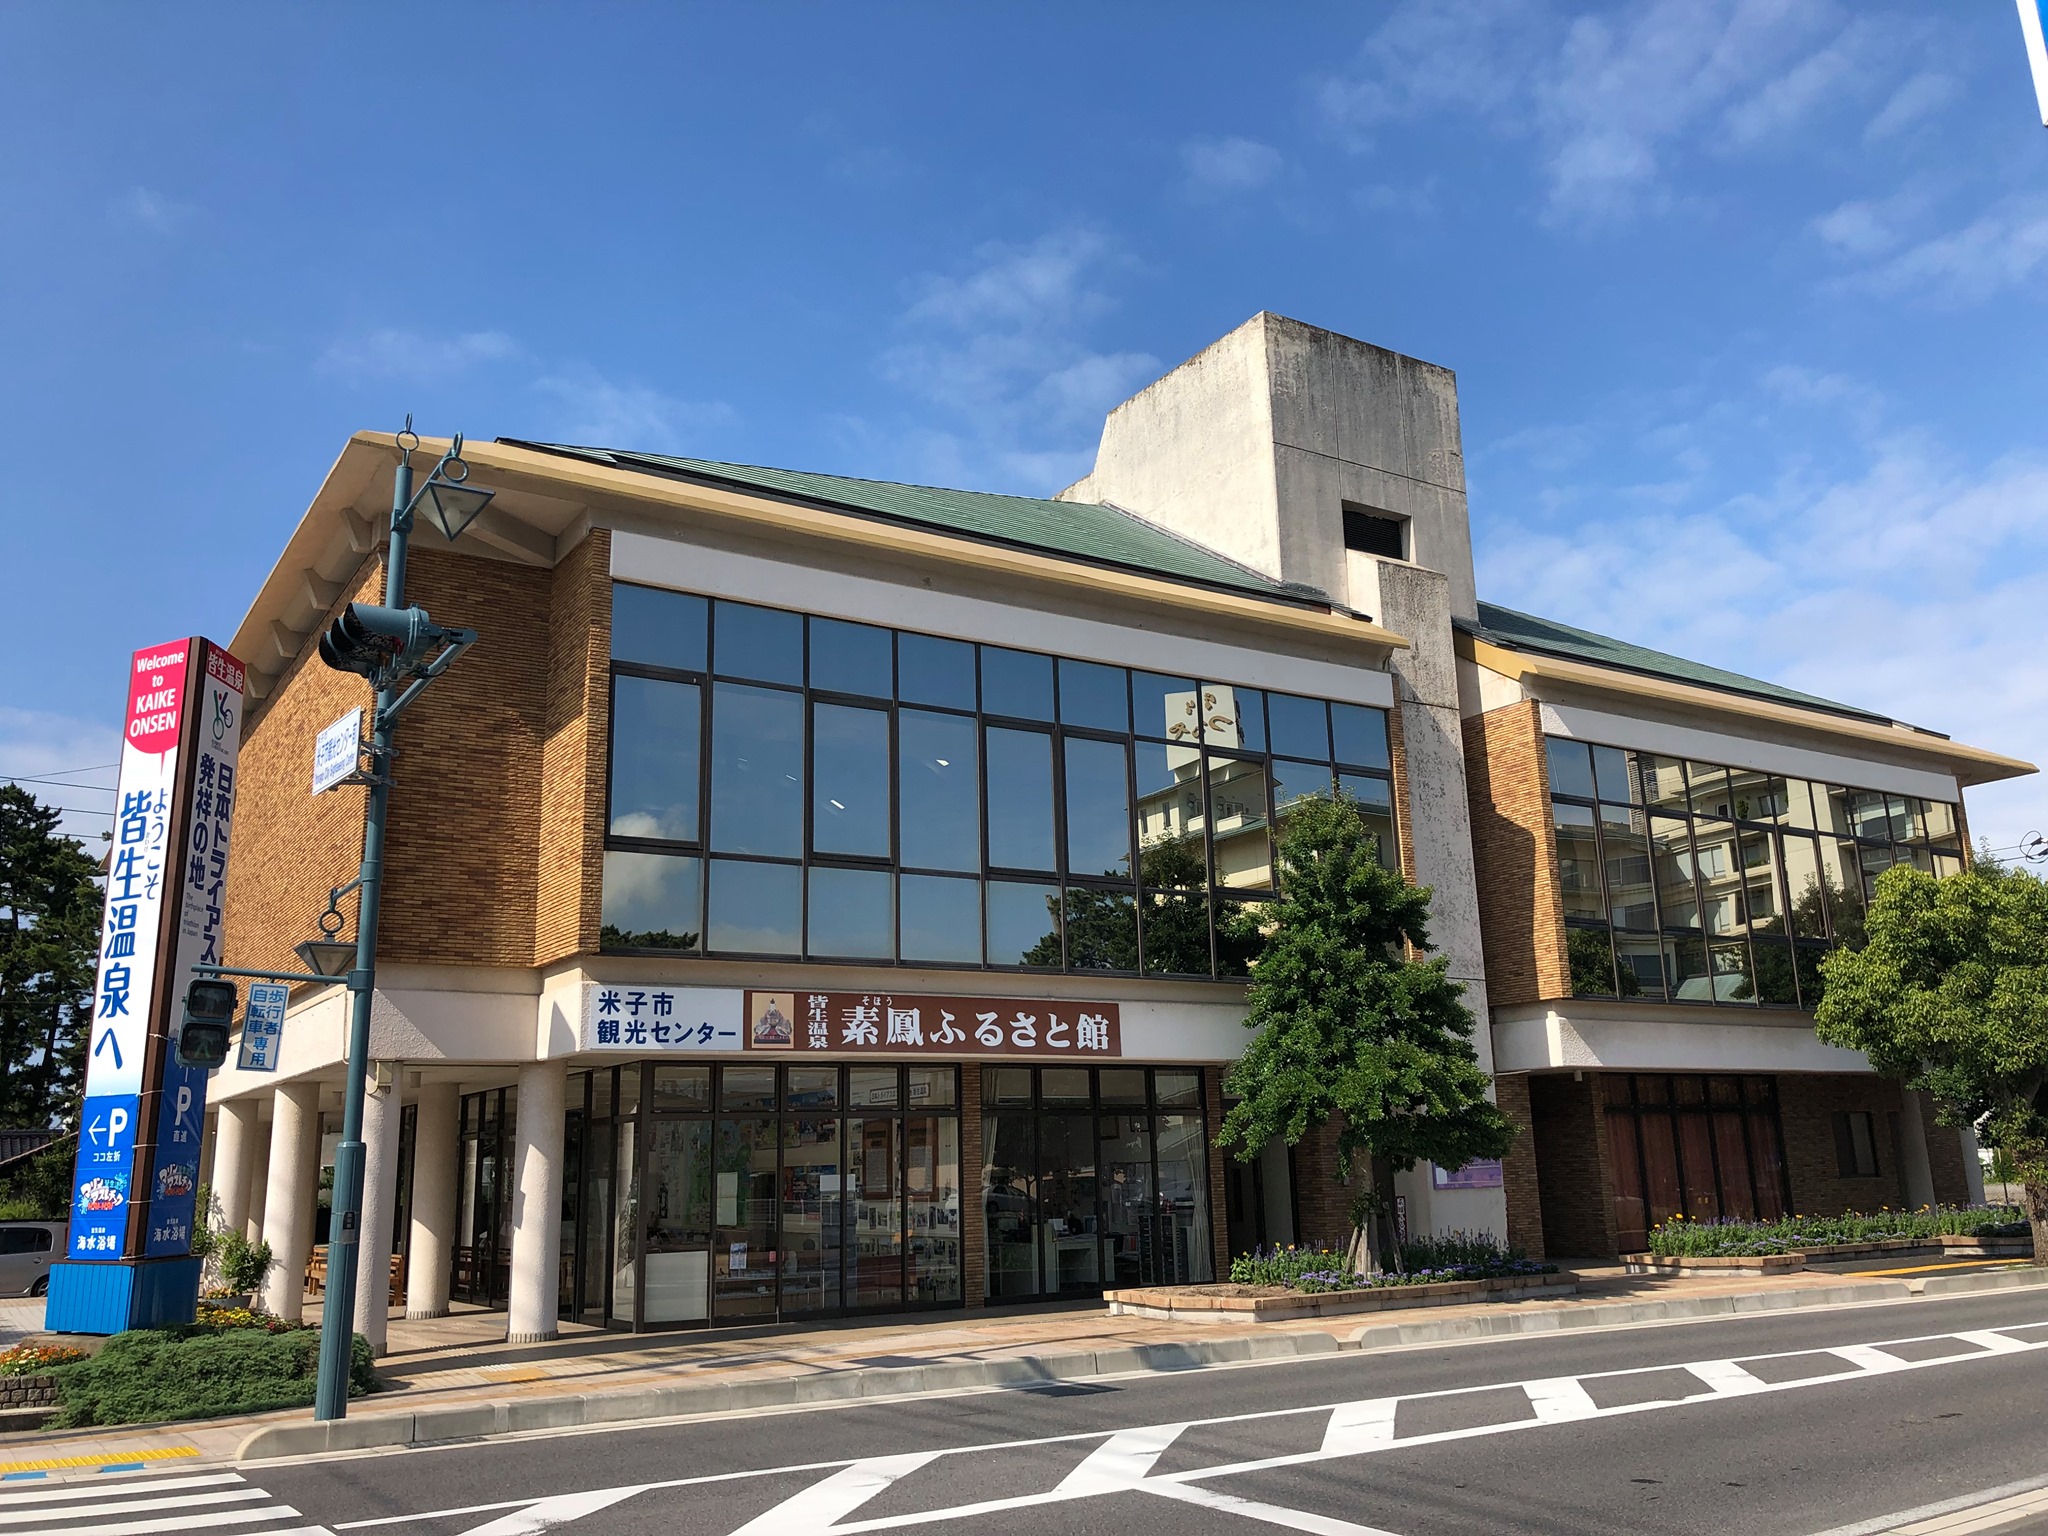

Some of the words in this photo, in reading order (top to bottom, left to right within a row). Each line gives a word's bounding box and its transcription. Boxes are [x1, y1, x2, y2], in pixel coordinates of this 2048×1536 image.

[137, 652, 184, 673] Welcome
[208, 651, 243, 692] 皆生温泉
[152, 675, 163, 687] to
[136, 688, 176, 714] KAIKE
[130, 711, 176, 738] ONSEN
[188, 753, 215, 890] 発祥の地
[144, 788, 168, 899] ようこそ
[200, 762, 233, 966] 日本トライアス
[95, 790, 152, 1070] 皆生温泉へ
[248, 989, 268, 1034] 自転車
[264, 990, 284, 1034] 歩行者
[598, 990, 674, 1016] 米子市
[862, 996, 893, 1006] そほう
[598, 1019, 736, 1044] 観光センター
[808, 994, 828, 1048] 皆生温泉
[841, 1006, 1109, 1050] 素鳳ふるさと館
[250, 1036, 269, 1065] 専用
[174, 1086, 191, 1126] P
[108, 1108, 128, 1147] P
[93, 1151, 121, 1163] ココ左折
[80, 1177, 104, 1199] マリン
[77, 1235, 116, 1251] 海水浴場
[153, 1227, 186, 1242] 海水浴場
